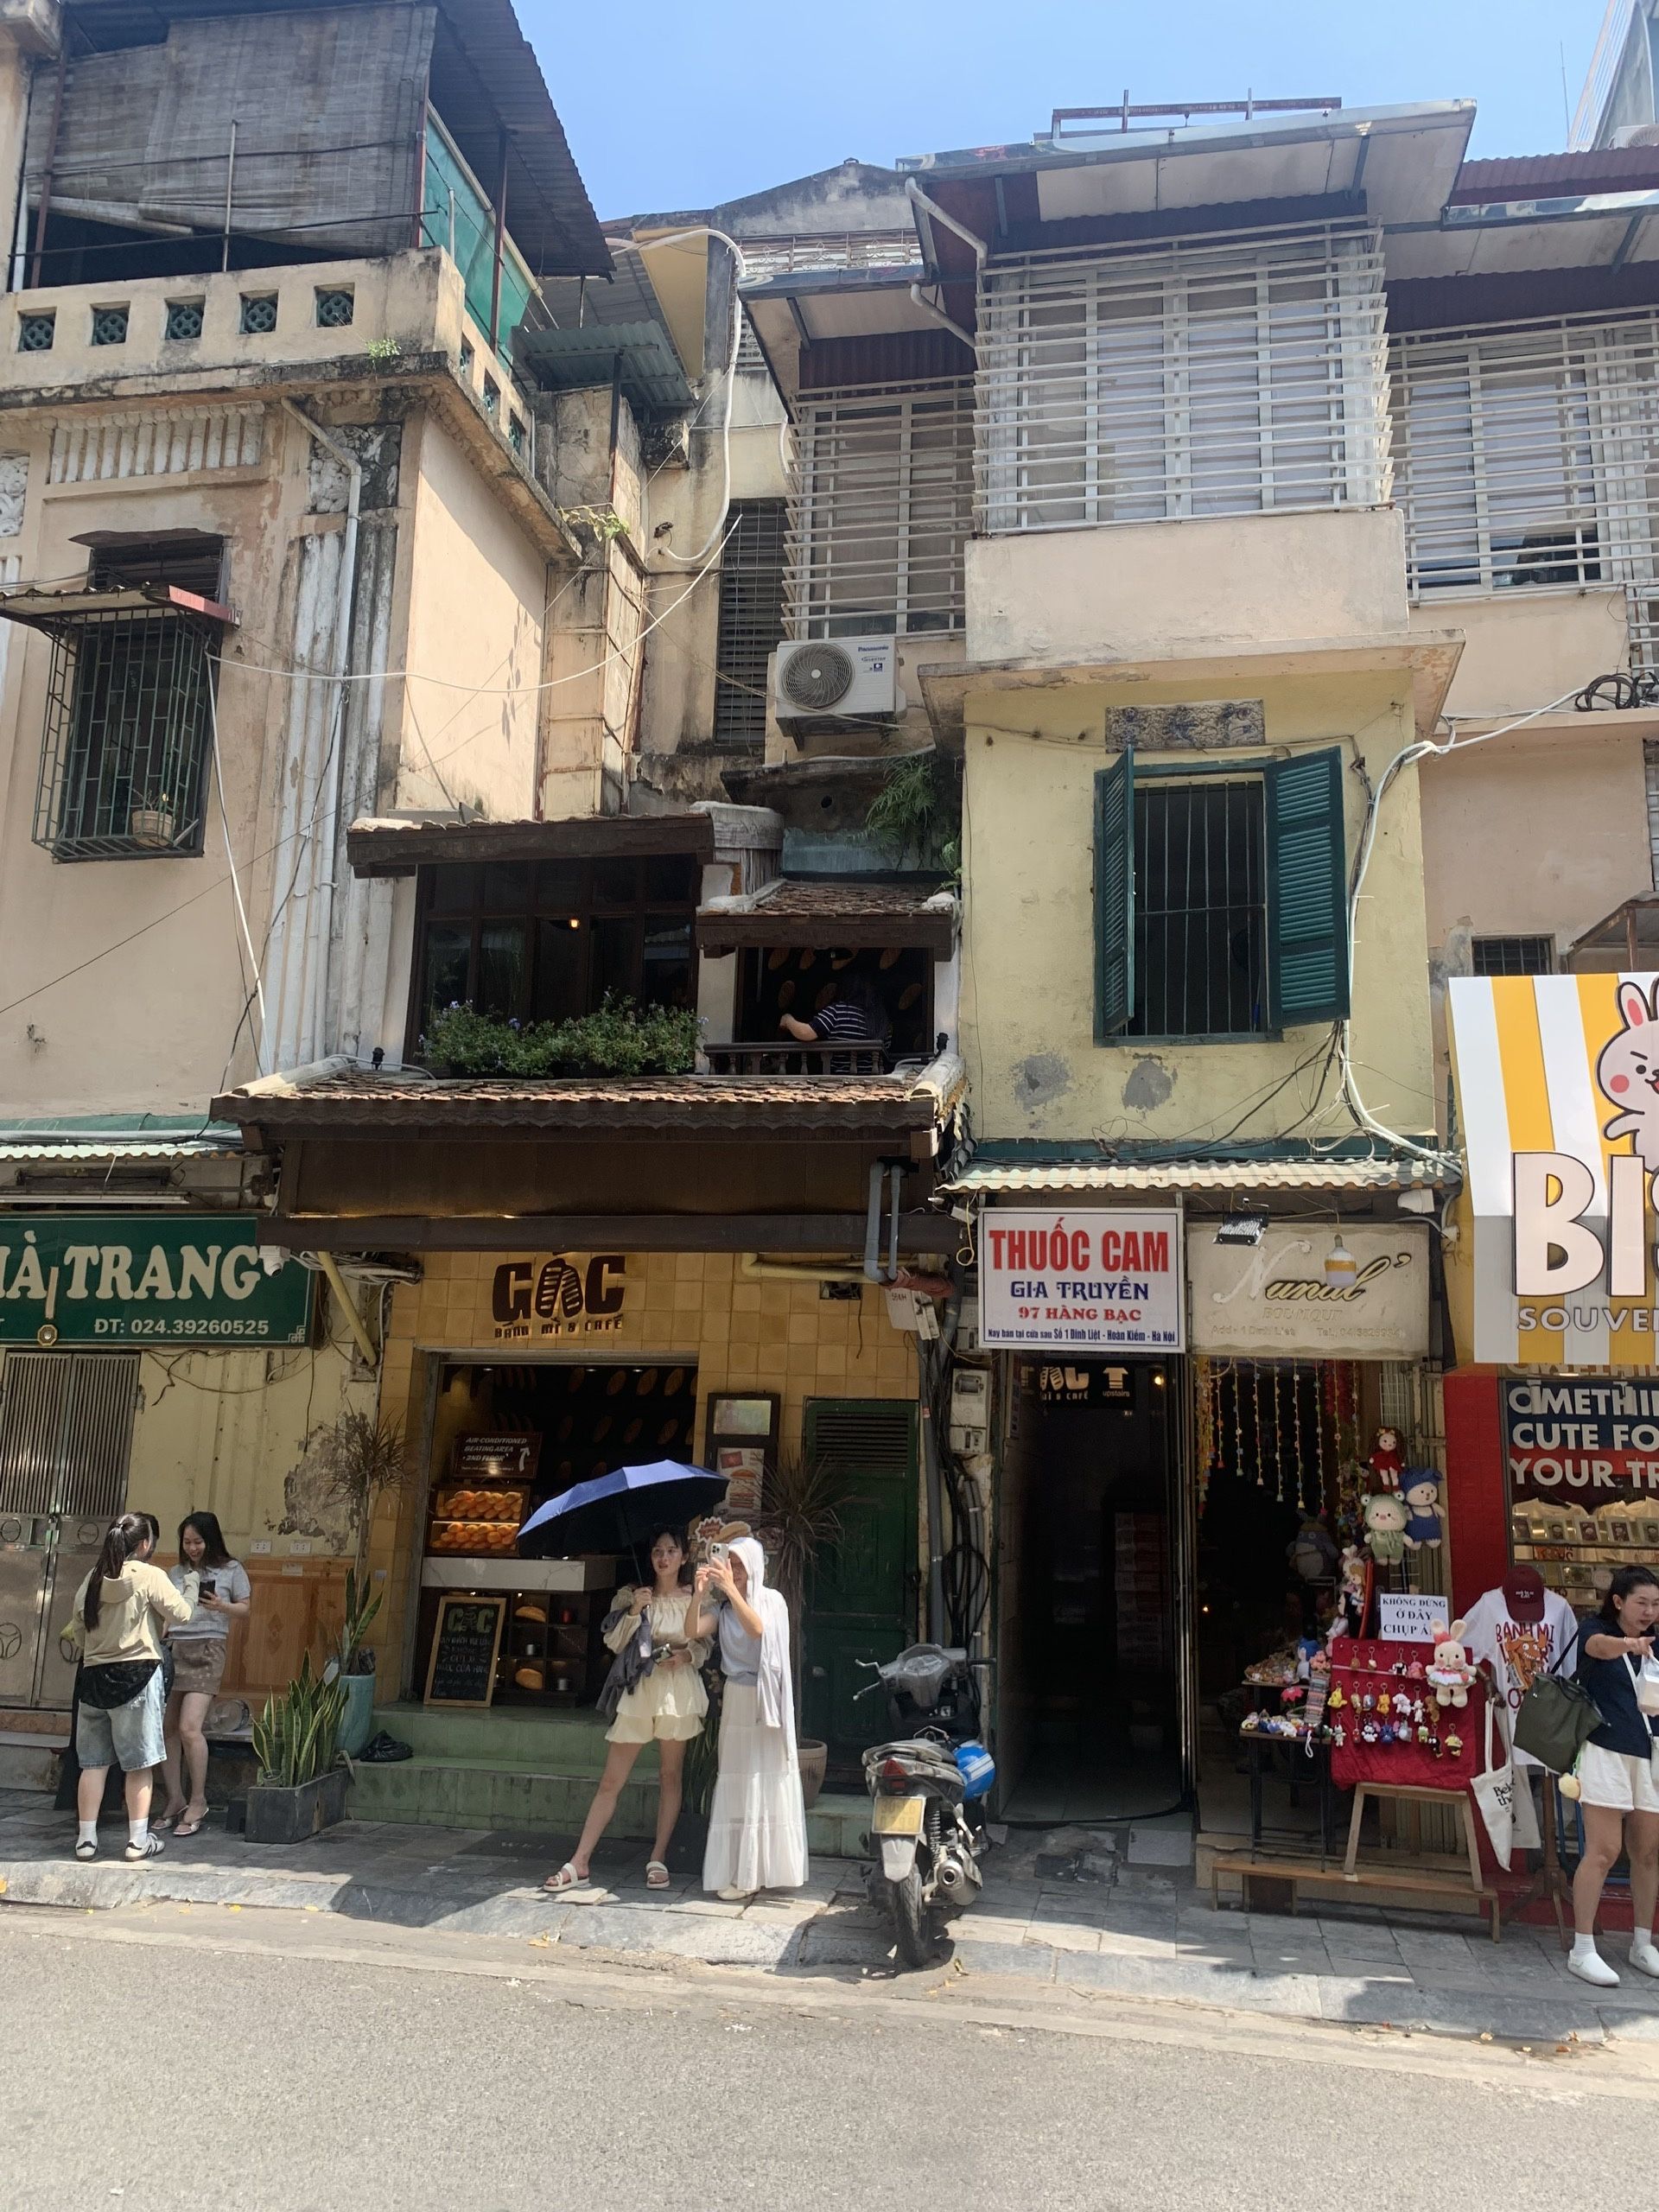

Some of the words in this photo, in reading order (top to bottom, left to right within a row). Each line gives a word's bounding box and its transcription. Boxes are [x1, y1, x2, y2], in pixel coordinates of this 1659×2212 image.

[988, 1217, 1090, 1271] THUỐC
[1102, 1230, 1169, 1273] CAM
[64, 1244, 261, 1300] TRANG
[1010, 1281, 1048, 1299] GIA
[1057, 1275, 1149, 1301] TRUYỀN
[1018, 1306, 1040, 1319] 97
[1046, 1305, 1097, 1320] HÀNG
[1103, 1309, 1141, 1324] BẠC
[94, 1319, 124, 1334] ĐT:
[130, 1319, 270, 1335] 024.39260525
[1065, 1329, 1069, 1339] 1
[1512, 1422, 1599, 1451] CUTE
[1613, 1424, 1659, 1452] FO
[1510, 1457, 1616, 1488] YOUR
[1382, 1596, 1416, 1605] KHÔNG
[1383, 1624, 1417, 1637] CHỤP
